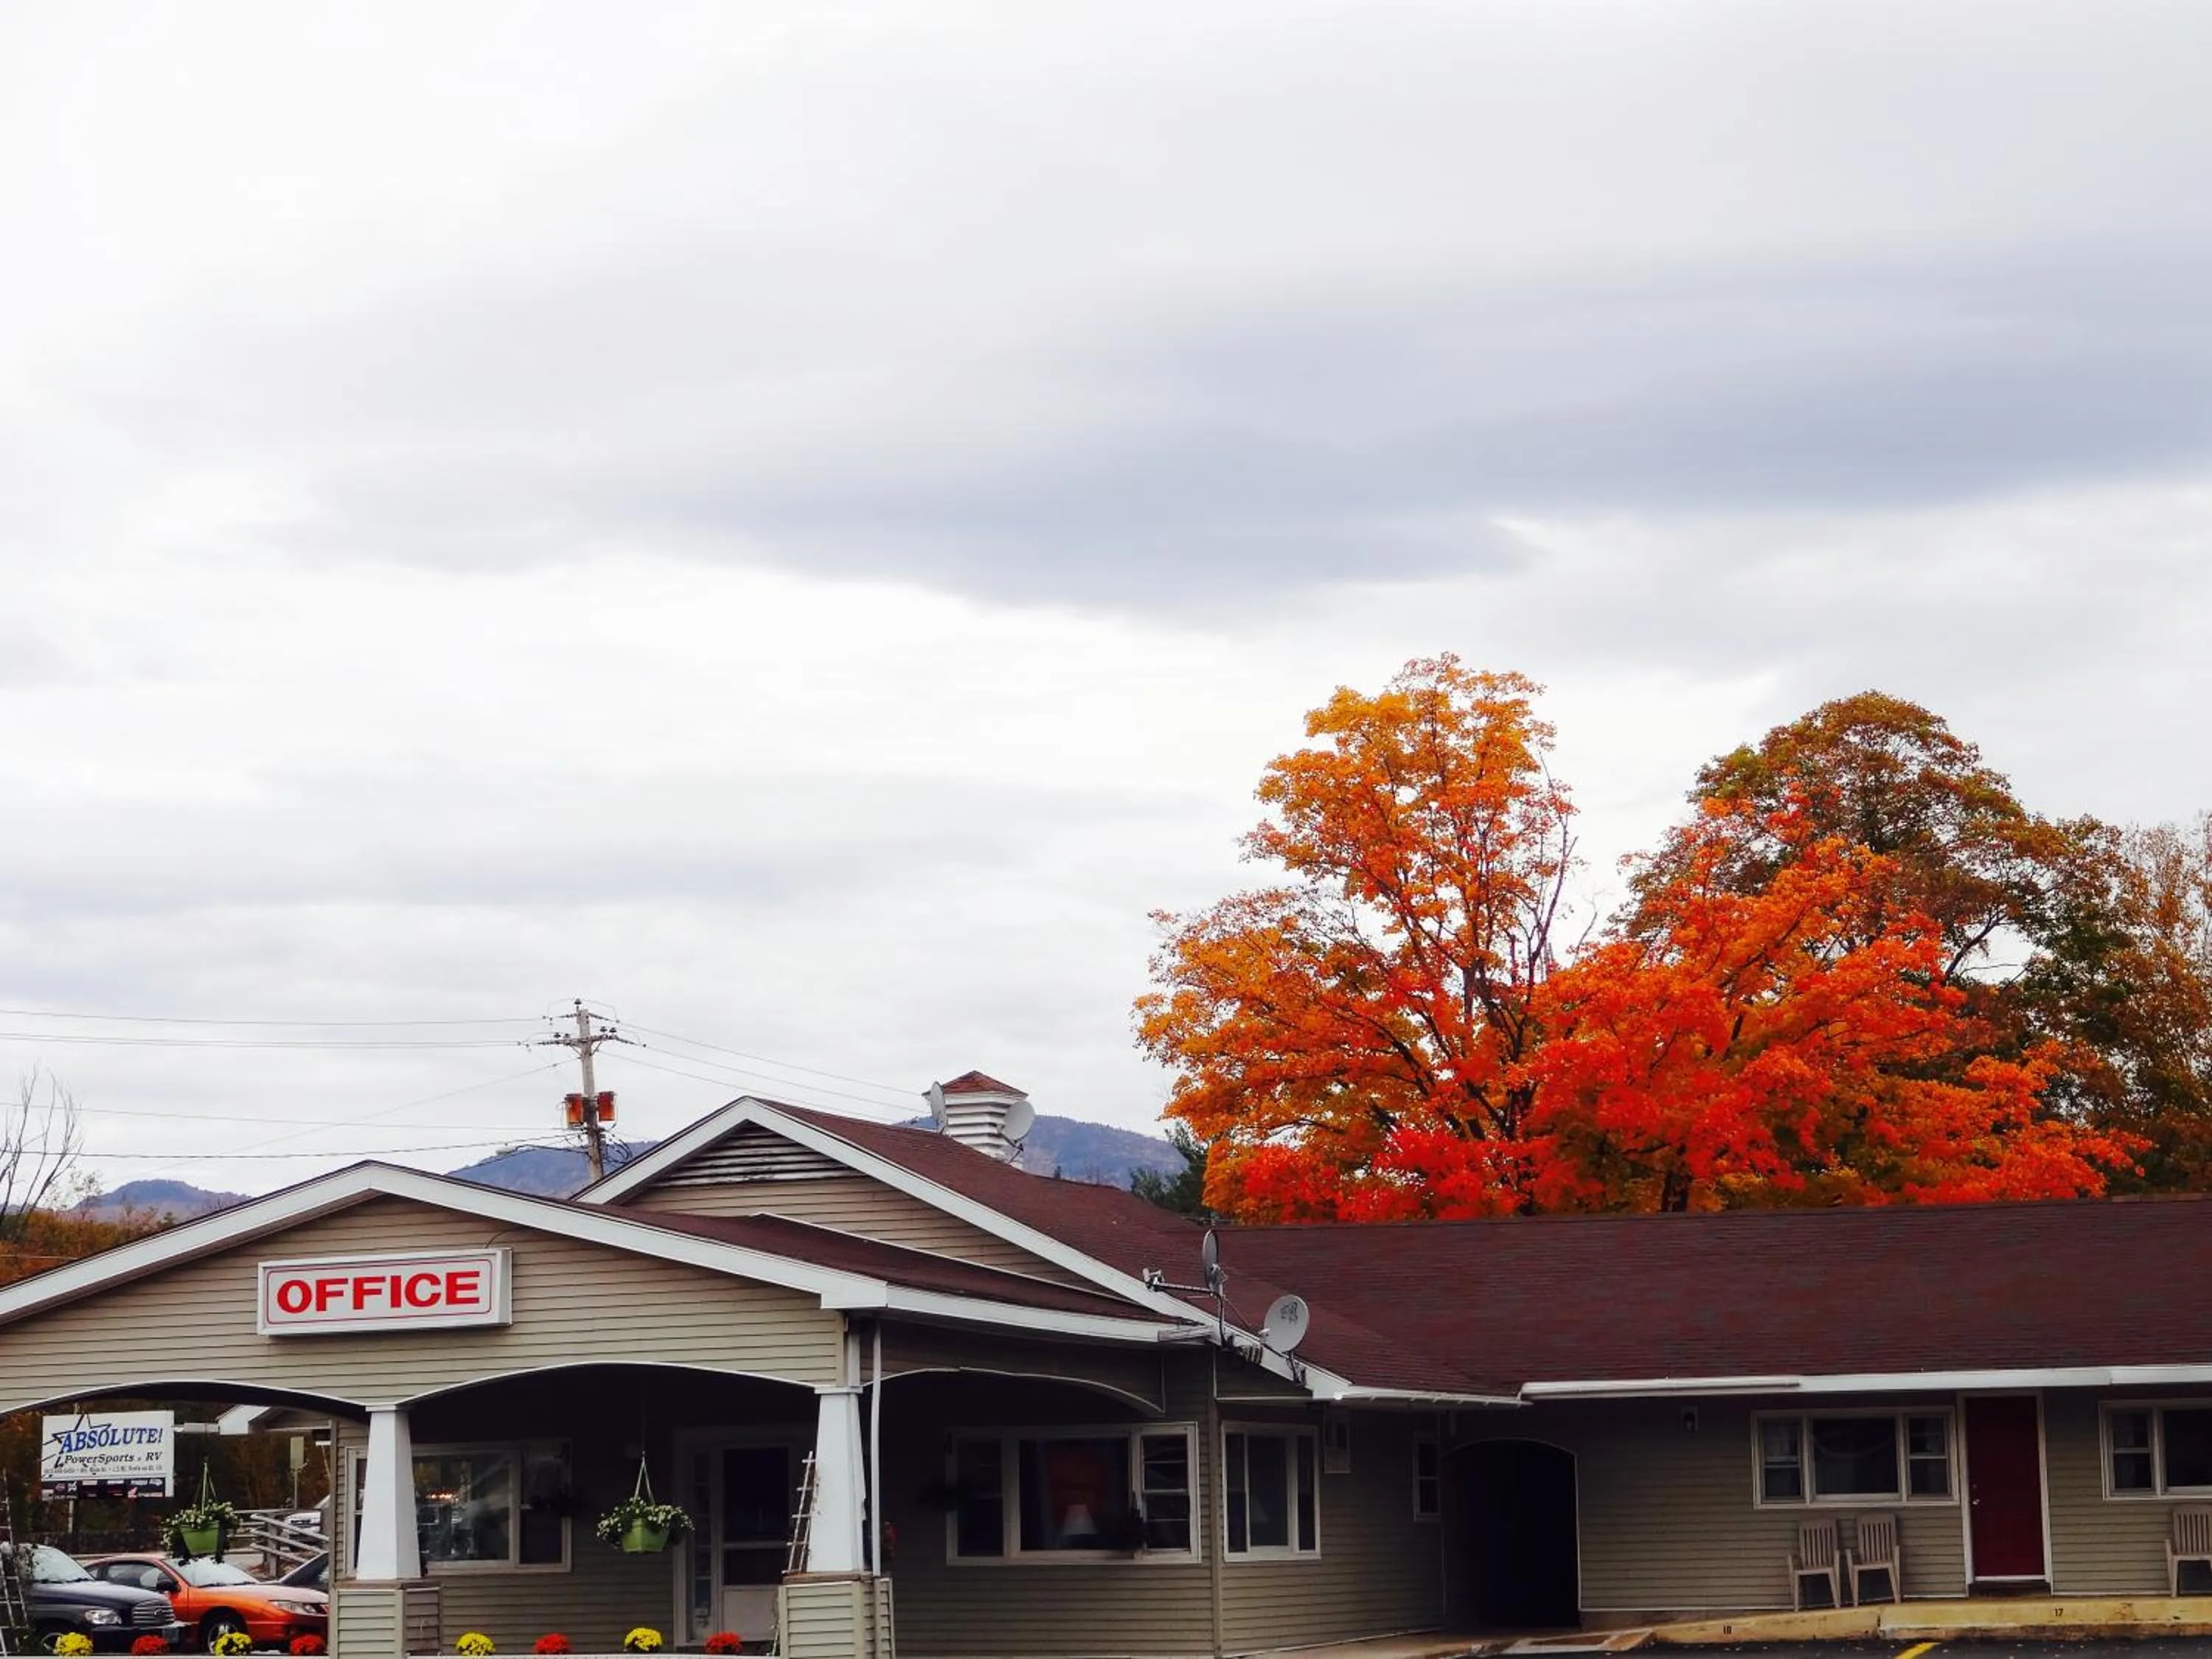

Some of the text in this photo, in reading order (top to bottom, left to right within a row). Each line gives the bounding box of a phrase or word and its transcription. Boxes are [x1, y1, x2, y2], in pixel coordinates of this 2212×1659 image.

[276, 1270, 480, 1313] OFFICE
[59, 1427, 163, 1453] ABSOLUTE!
[65, 1451, 163, 1465] PowerSports RV
[2055, 1608, 2064, 1617] 17
